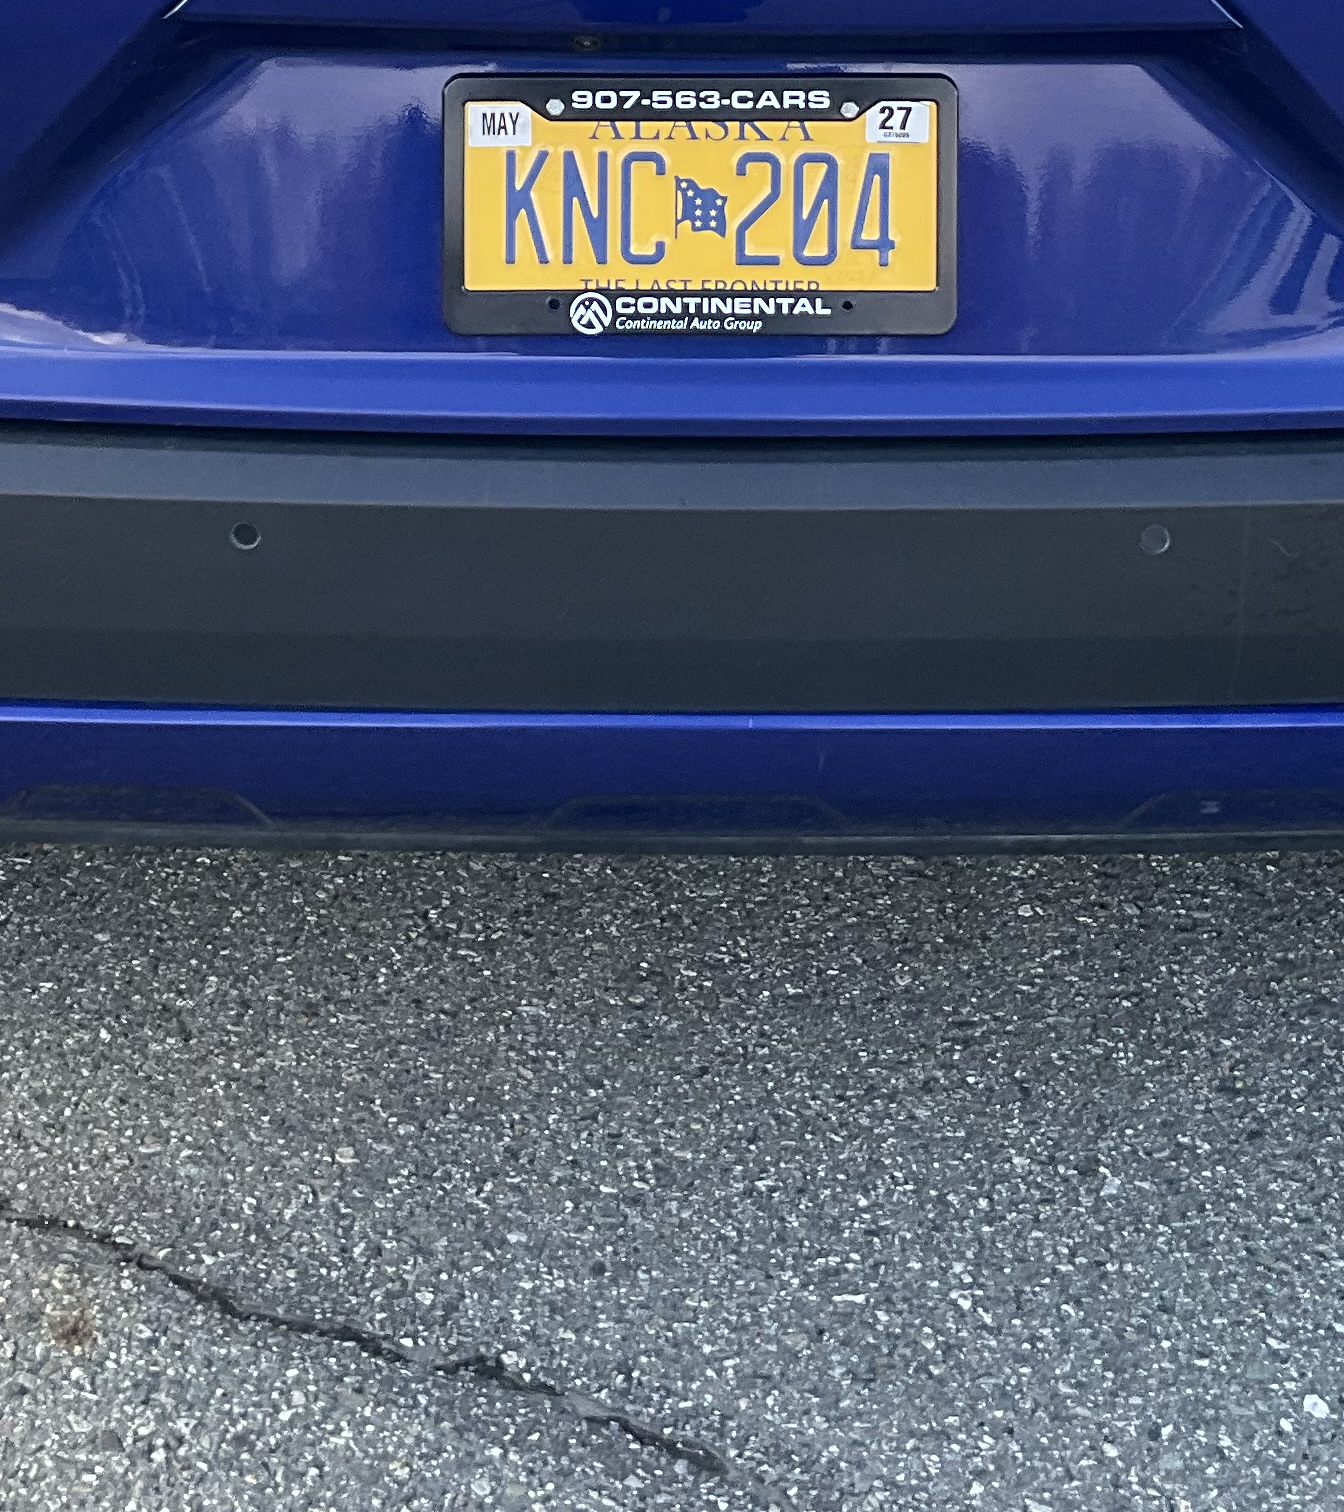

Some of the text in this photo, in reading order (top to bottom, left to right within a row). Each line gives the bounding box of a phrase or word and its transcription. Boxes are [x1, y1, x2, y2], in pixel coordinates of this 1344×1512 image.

[571, 90, 831, 110] 907-563-CARS
[482, 112, 520, 136] MAY
[878, 105, 913, 131] 27
[588, 120, 815, 141] ALASKA
[505, 150, 895, 267] KNC 204
[615, 296, 832, 315] CONTINENTAL
[615, 316, 763, 333] Continental Auto Group
